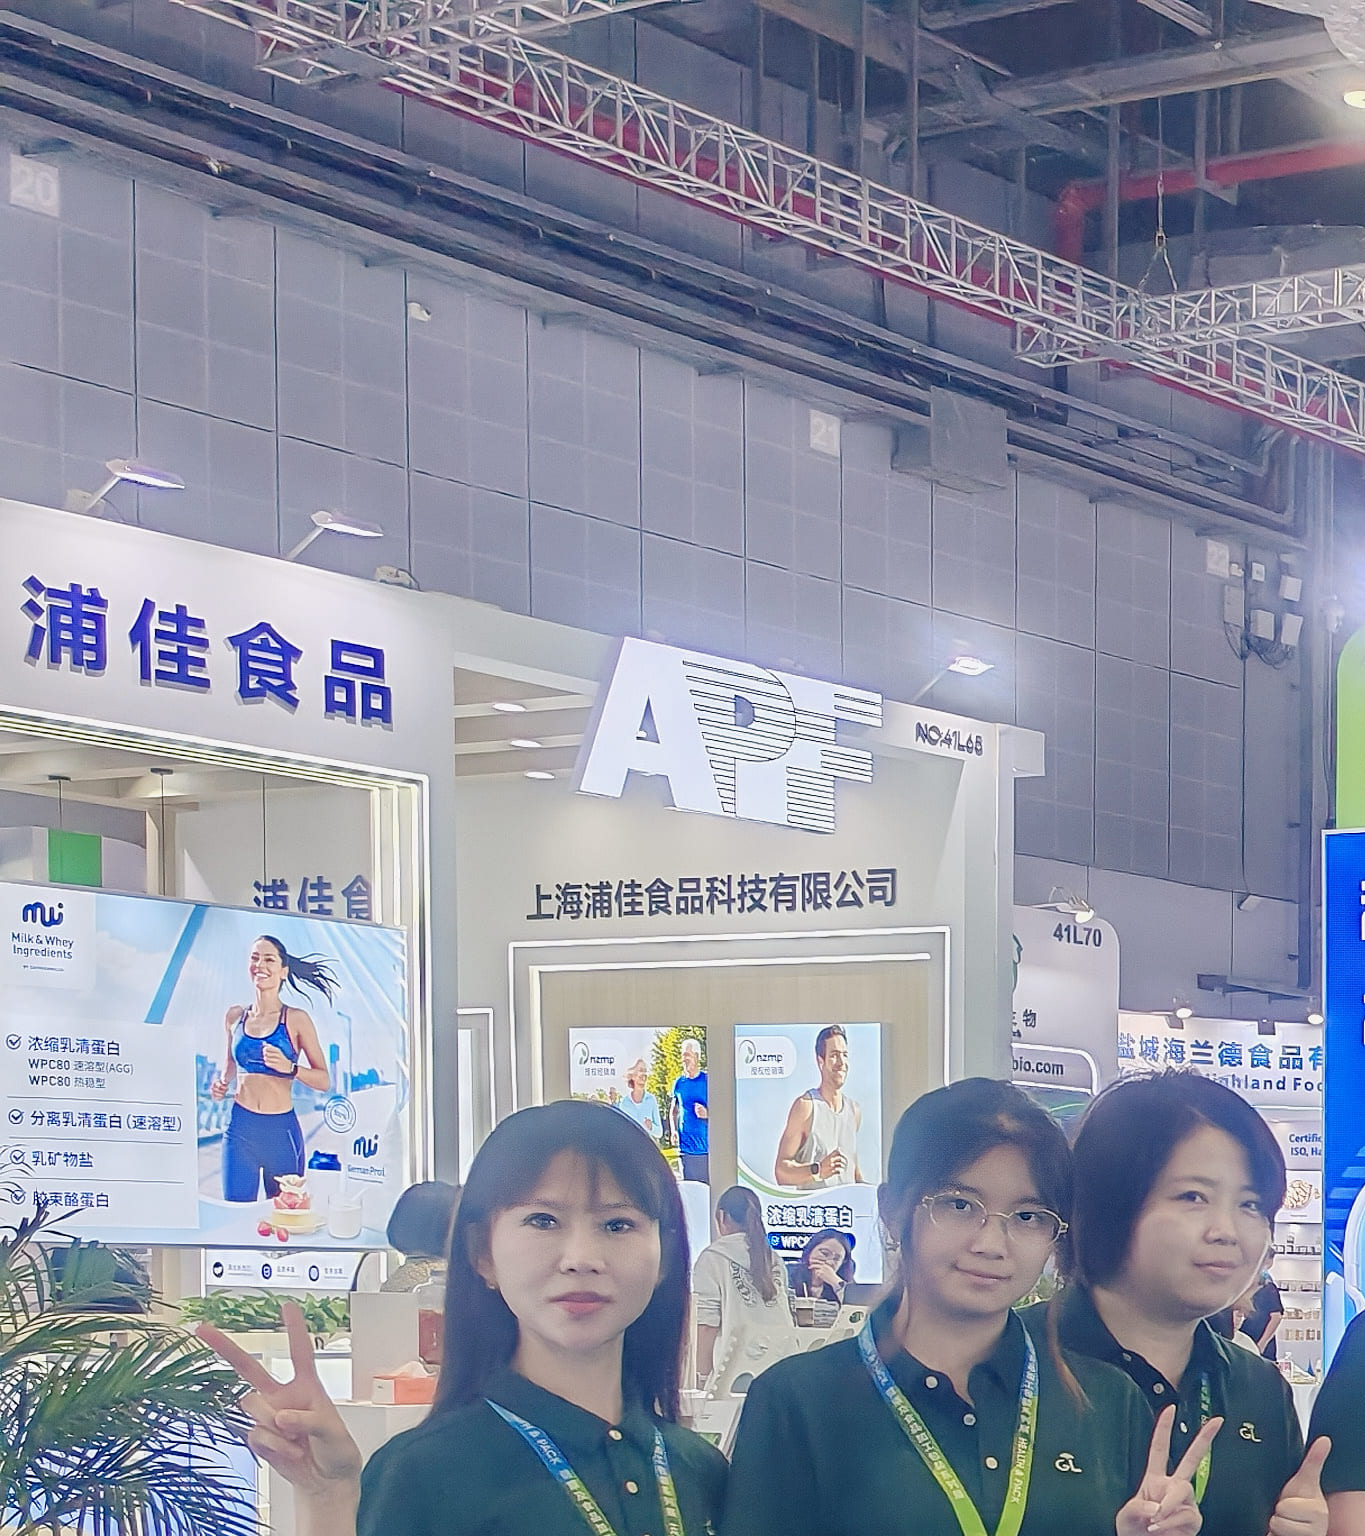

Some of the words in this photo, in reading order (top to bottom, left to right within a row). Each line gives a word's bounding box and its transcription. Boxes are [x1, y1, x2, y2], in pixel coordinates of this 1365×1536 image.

[20, 574, 392, 730] 浦佳食品
[526, 867, 898, 921] 上海浦佳食品科技有限公司
[11, 931, 35, 944] Milk
[35, 934, 43, 945] &
[44, 935, 75, 950] Whey
[1052, 922, 1103, 948] 41L70
[12, 944, 74, 960] Ingredients
[28, 1035, 121, 1057] 浓缩乳清蛋白
[28, 1058, 71, 1071] WPC80
[28, 1075, 71, 1088] WPC80
[31, 1151, 95, 1168] 乳矿物盐
[767, 1204, 853, 1228] 浓缩乳清蛋白
[536, 1439, 562, 1465] PACK
